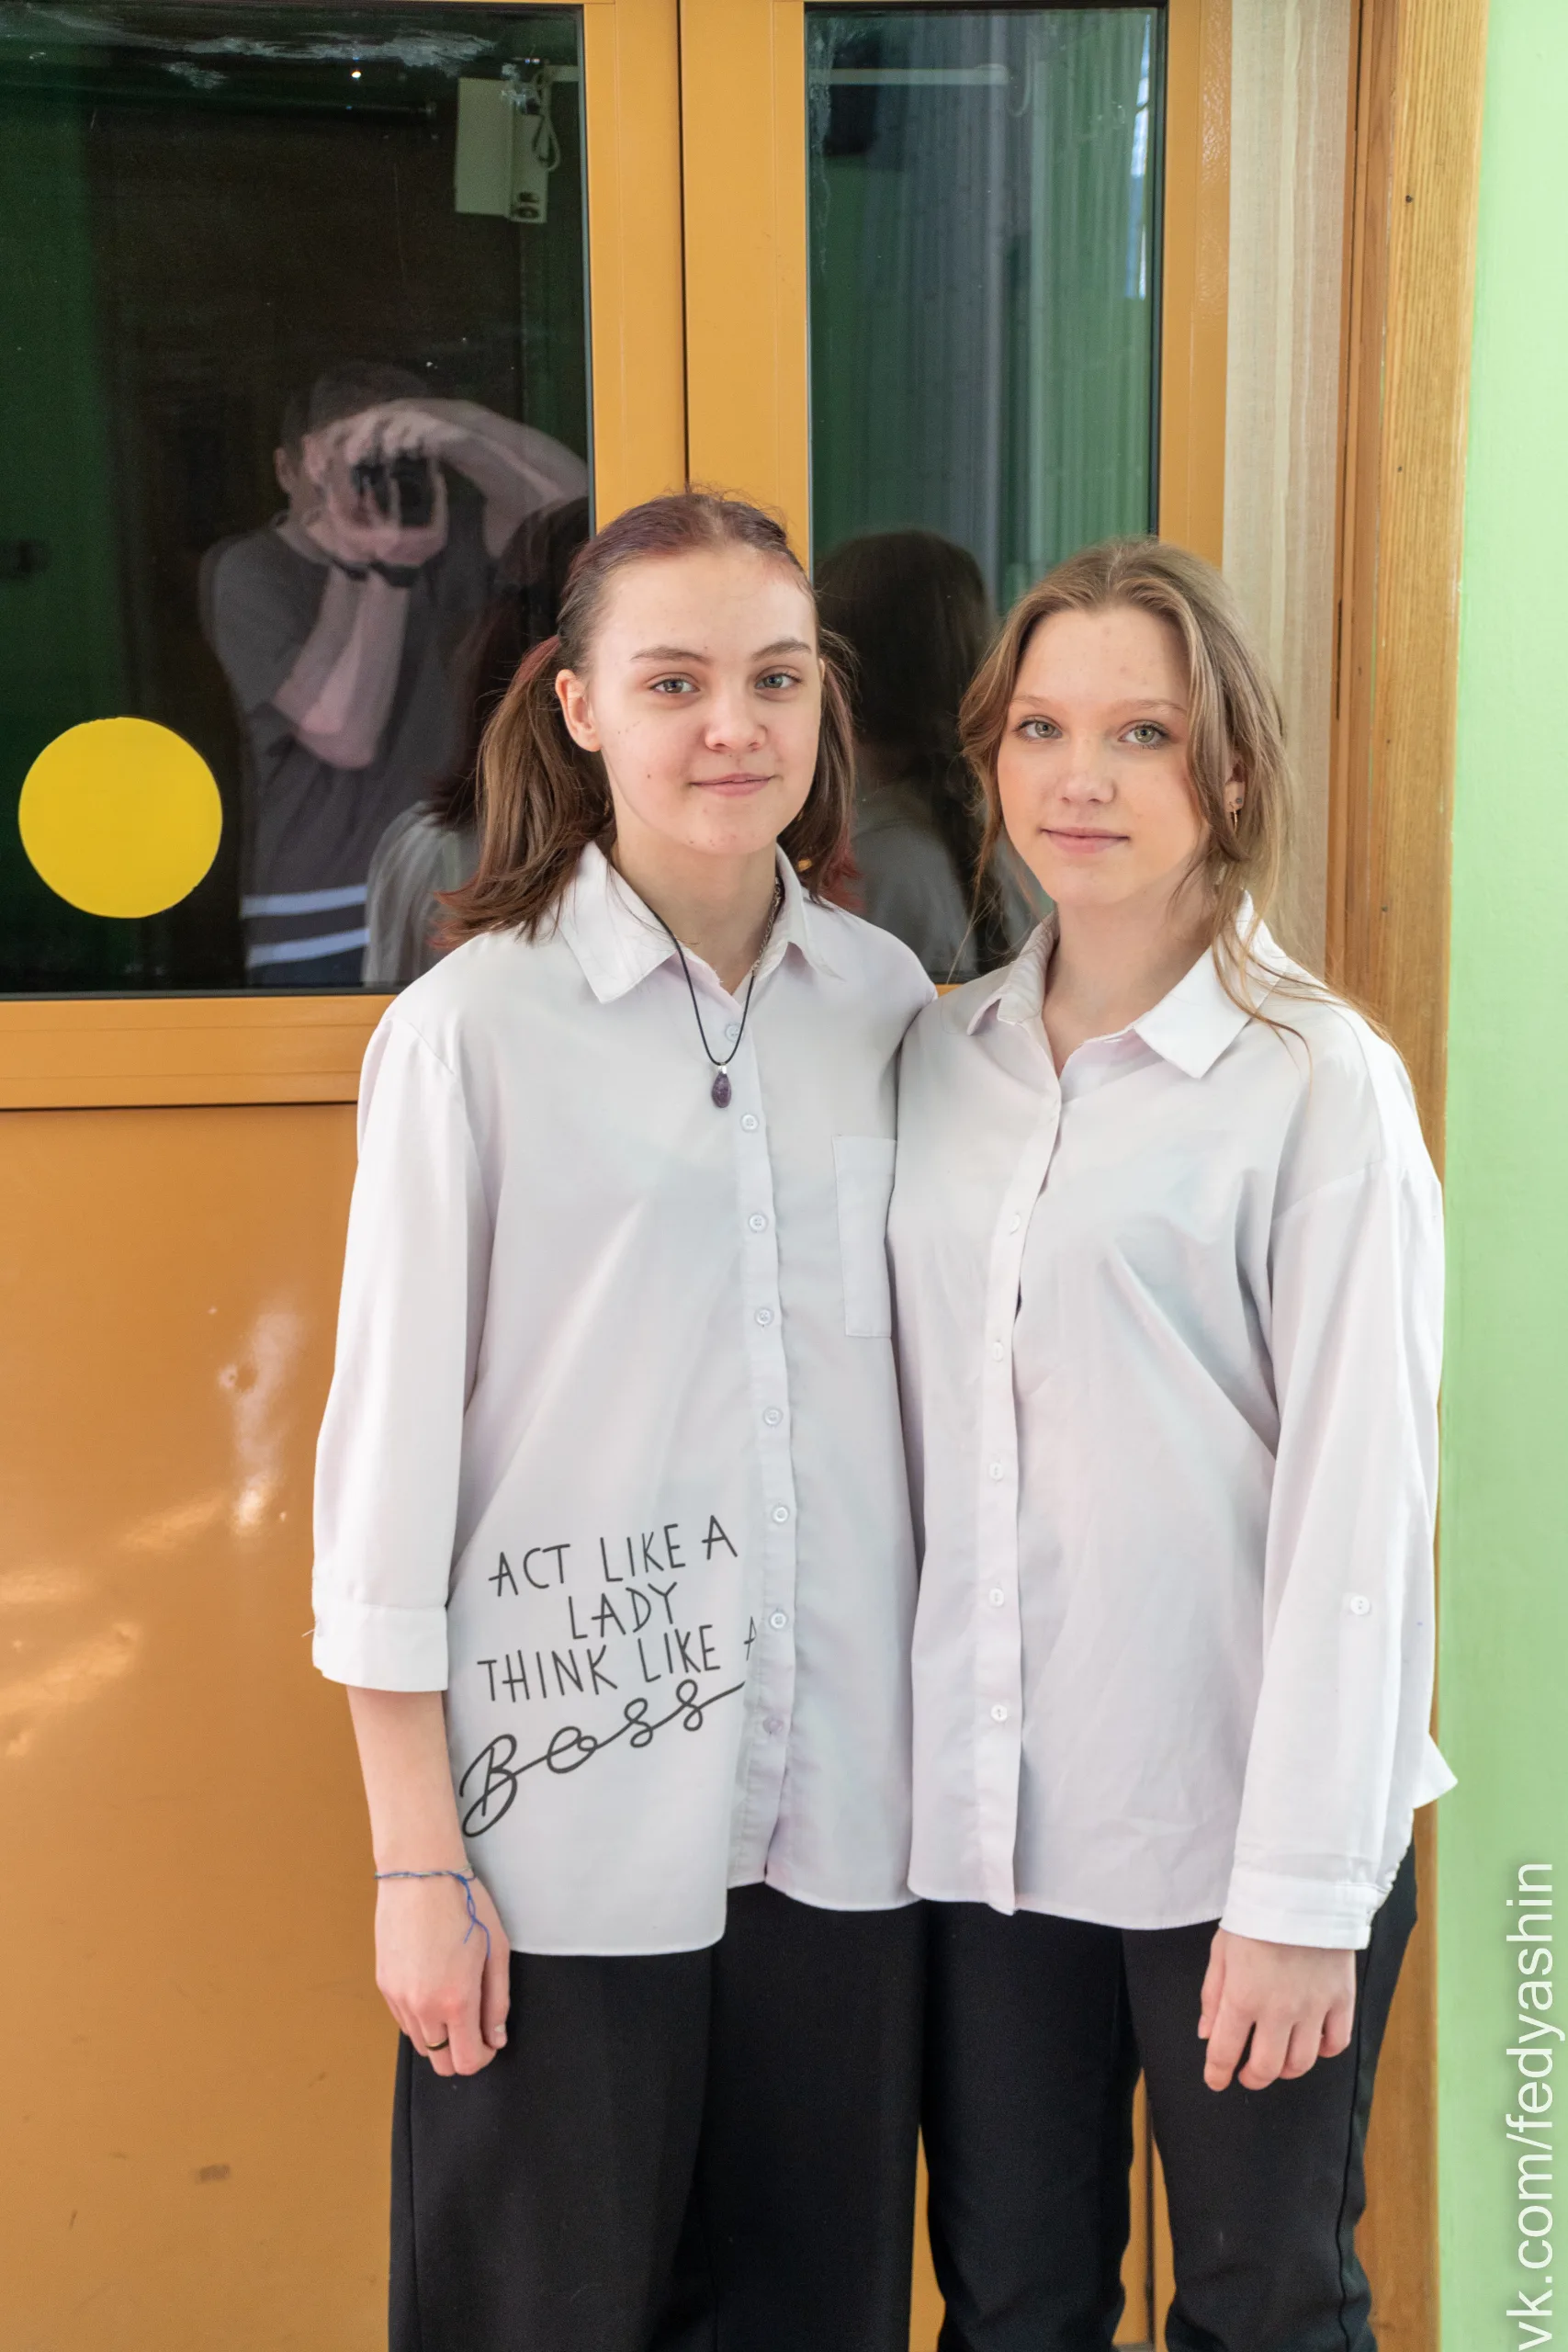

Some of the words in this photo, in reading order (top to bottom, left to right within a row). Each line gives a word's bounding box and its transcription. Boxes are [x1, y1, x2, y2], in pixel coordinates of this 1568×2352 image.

[488, 1543, 570, 1597] ACT
[600, 1523, 686, 1582] LIKE
[702, 1515, 738, 1560] A
[568, 1582, 677, 1640] LADY
[477, 1645, 617, 1702] THINK
[637, 1624, 721, 1682] LIKE
[459, 1679, 745, 1838] Boss
